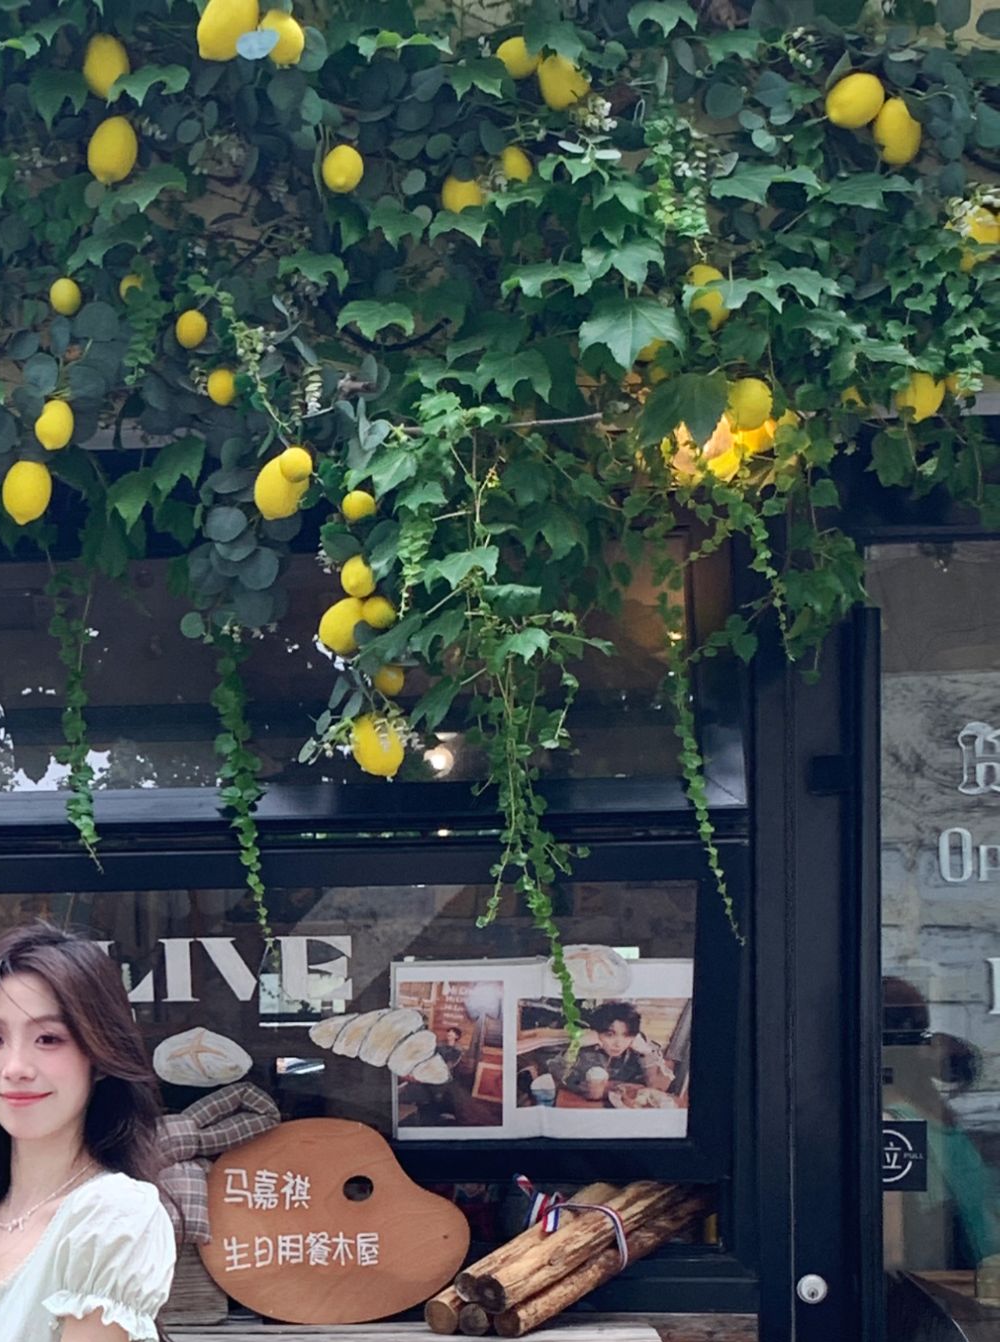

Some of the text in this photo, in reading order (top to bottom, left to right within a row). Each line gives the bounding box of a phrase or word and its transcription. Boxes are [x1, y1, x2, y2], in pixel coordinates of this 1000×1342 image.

[903, 1152, 924, 1160] PULL
[223, 1168, 312, 1211] 马嘉祺
[223, 1231, 380, 1272] 生日用餐木屋
